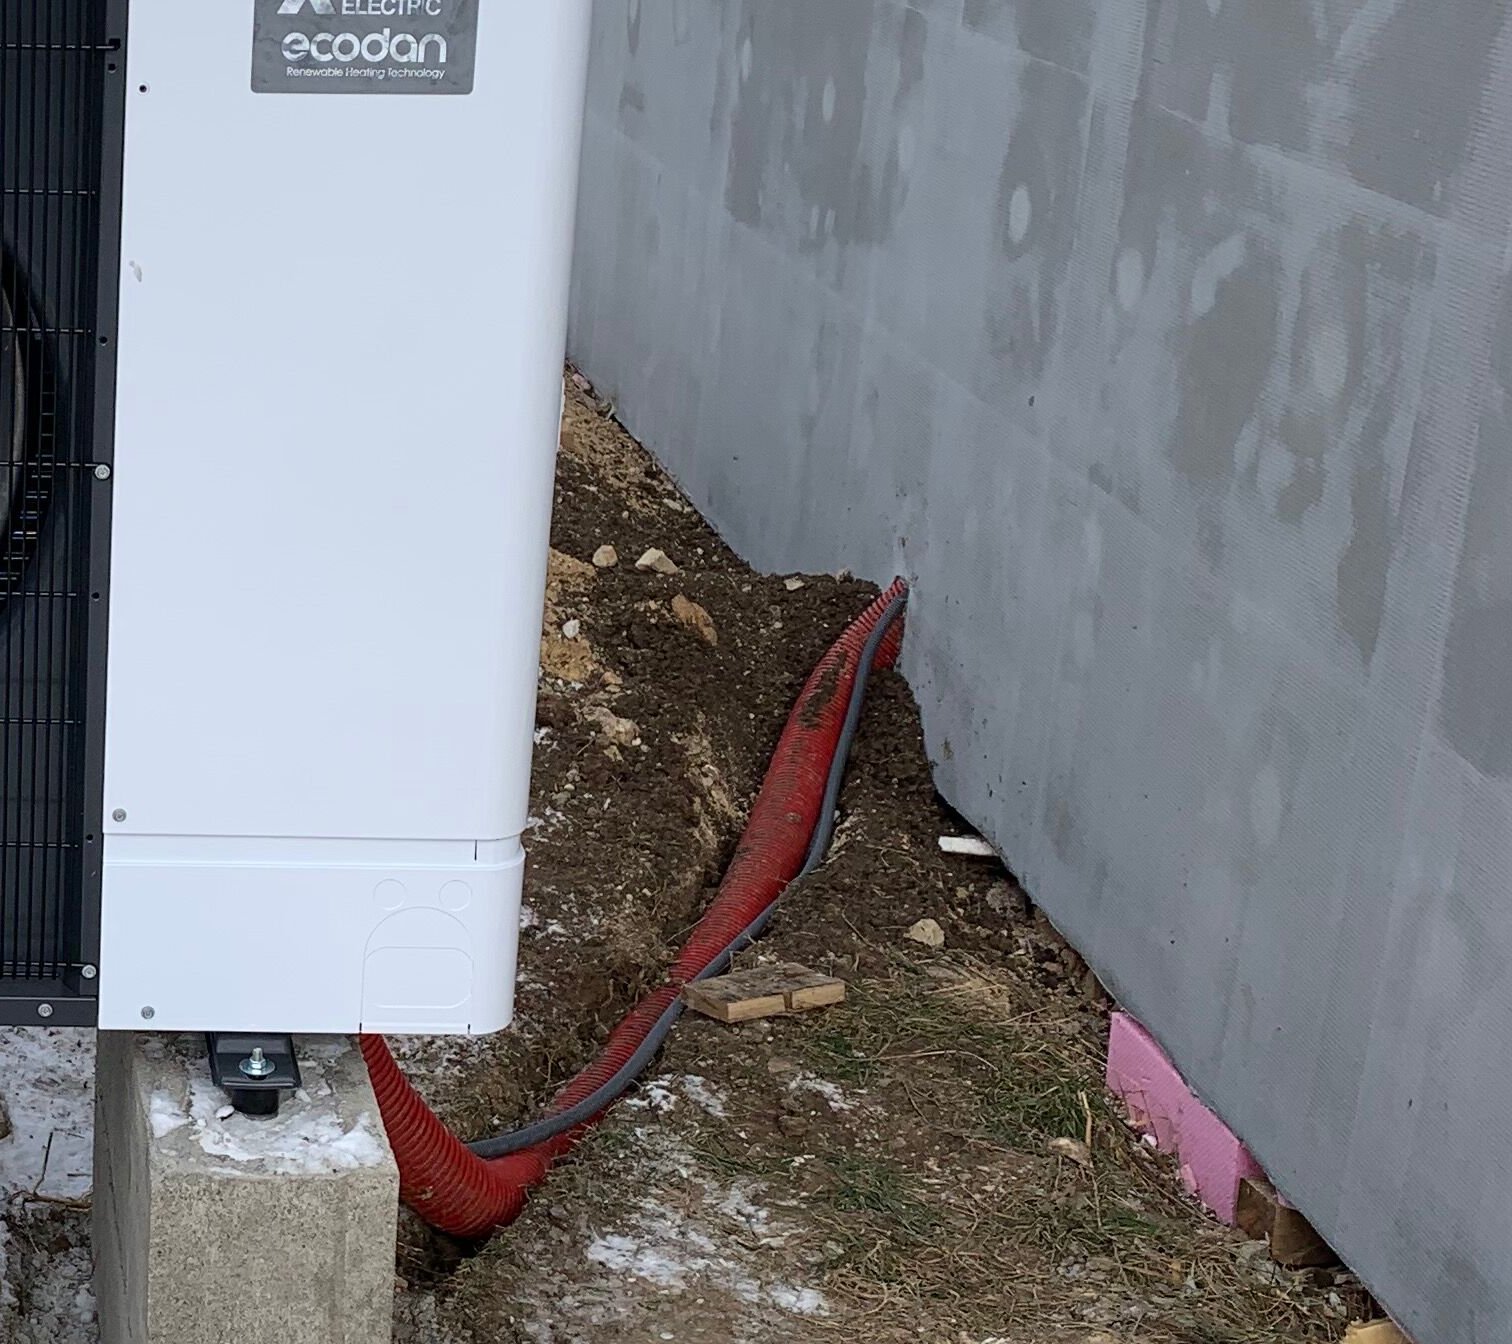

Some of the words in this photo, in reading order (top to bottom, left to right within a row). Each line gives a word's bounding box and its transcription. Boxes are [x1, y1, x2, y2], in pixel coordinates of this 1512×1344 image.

[281, 27, 447, 63] ecodan
[286, 66, 344, 78] Renewable
[345, 66, 386, 80] Heating
[387, 66, 446, 80] Technology
